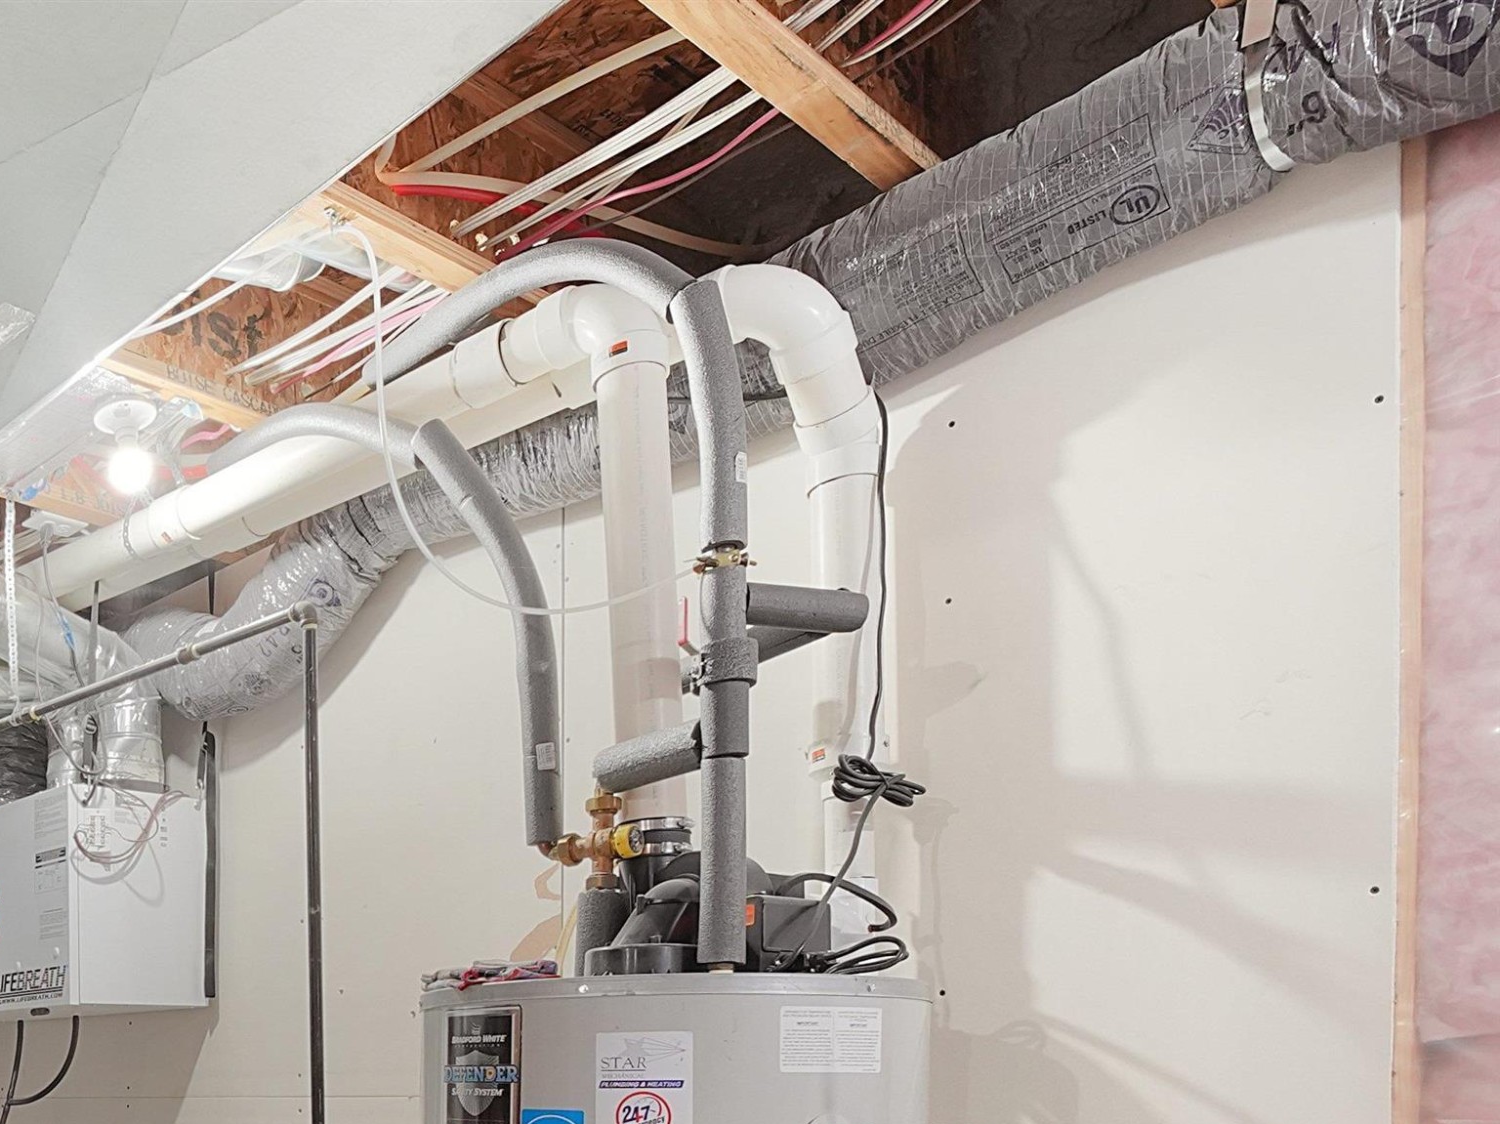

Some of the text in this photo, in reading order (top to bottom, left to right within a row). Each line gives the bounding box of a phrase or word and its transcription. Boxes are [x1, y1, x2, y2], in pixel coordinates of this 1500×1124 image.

[1068, 209, 1107, 235] LISTED
[482, 1035, 507, 1043] WHITE
[600, 1056, 647, 1069] STAR
[444, 1065, 519, 1083] DEFENDER
[452, 1088, 504, 1097] SATY SYSTEM
